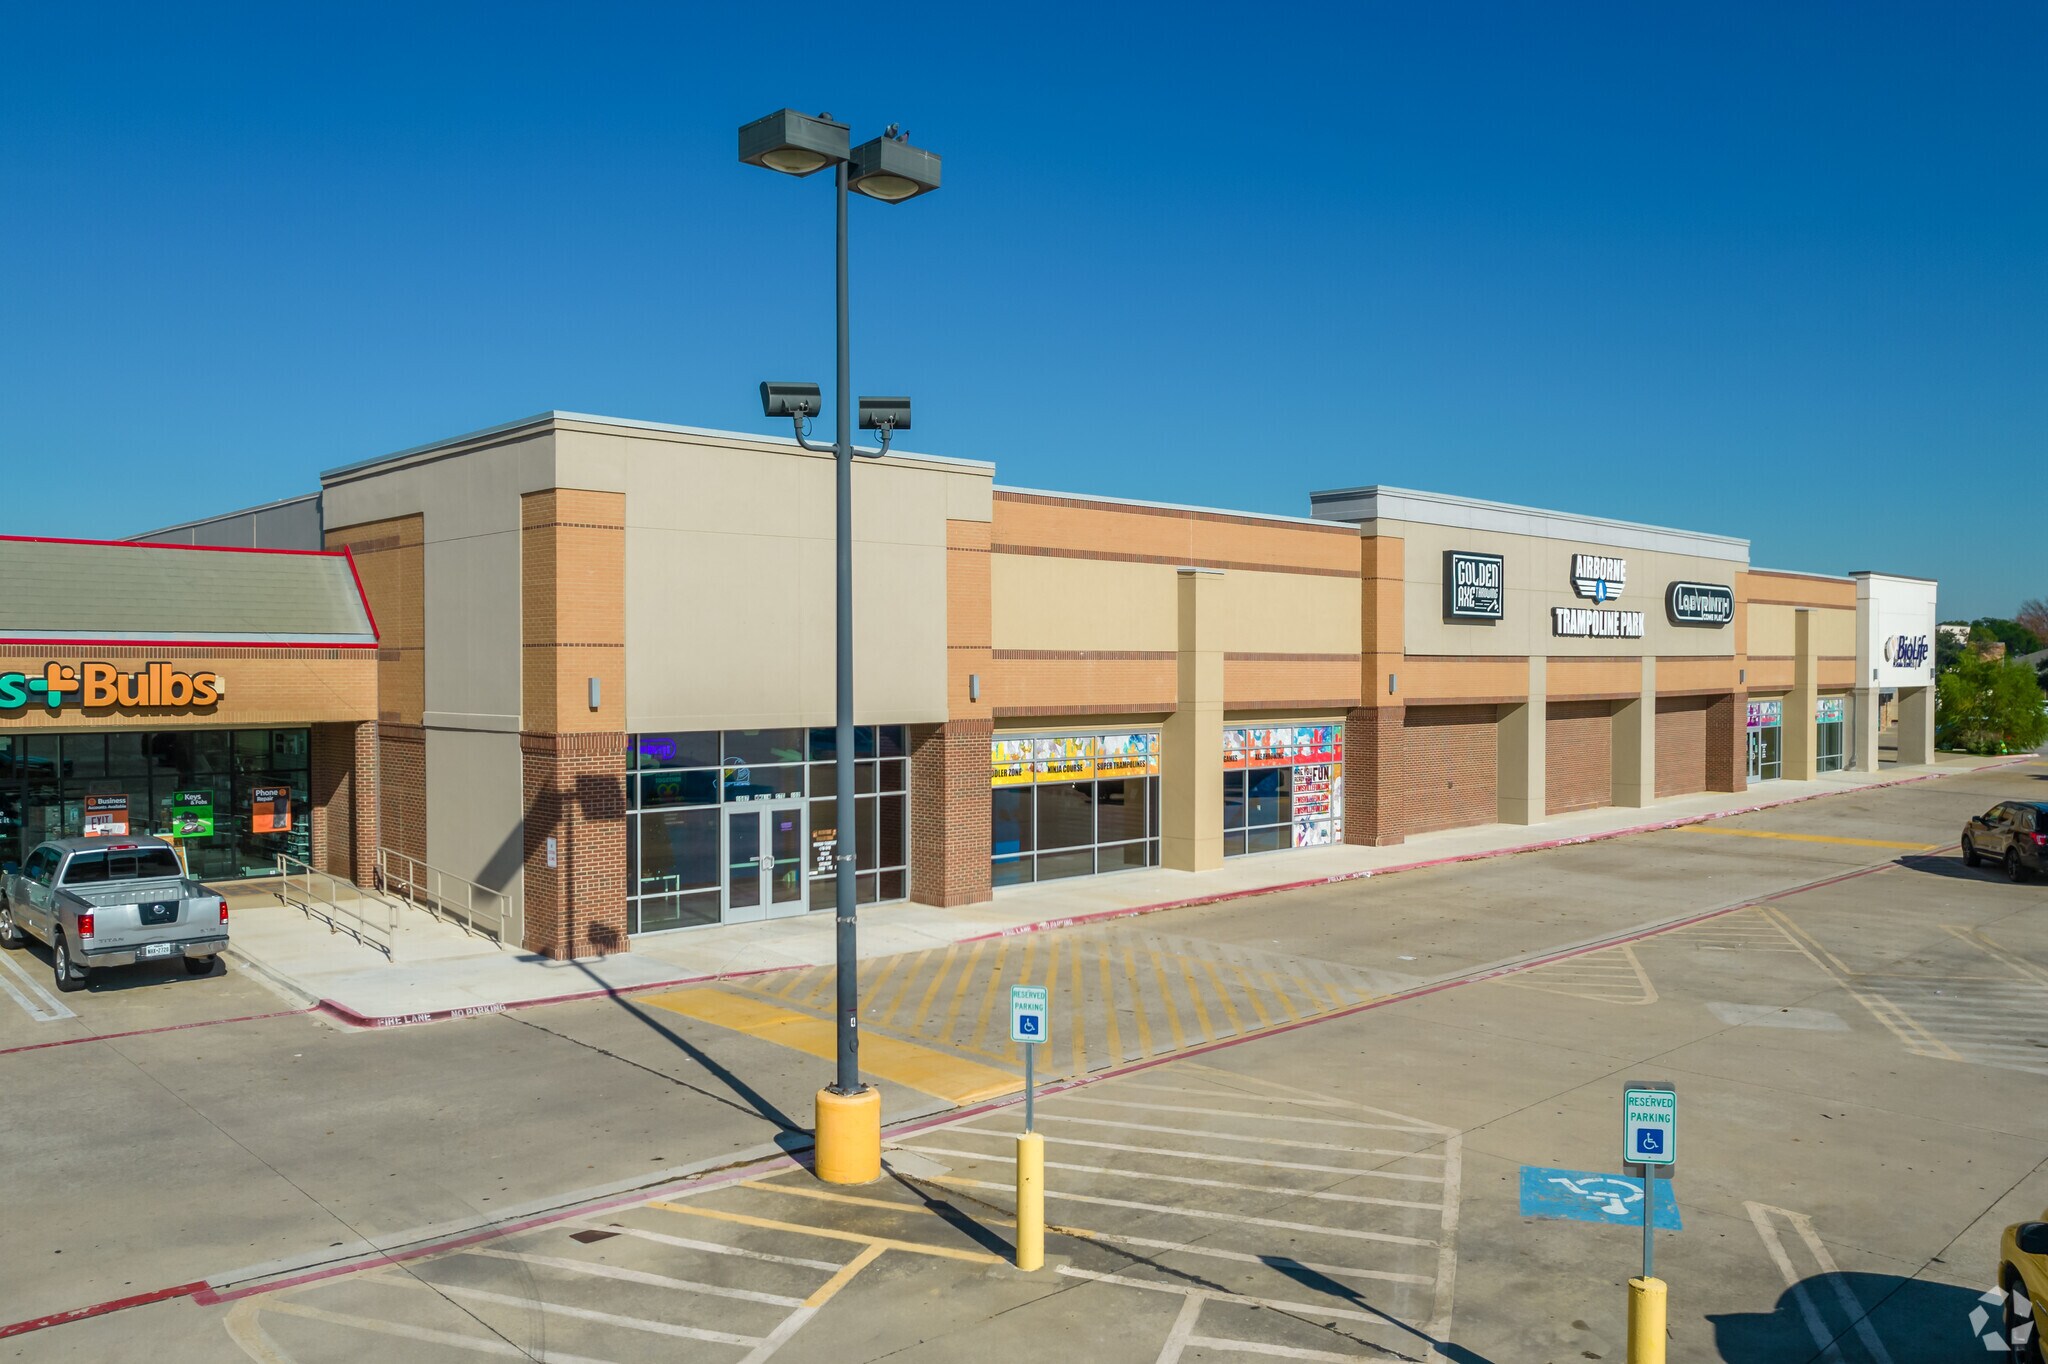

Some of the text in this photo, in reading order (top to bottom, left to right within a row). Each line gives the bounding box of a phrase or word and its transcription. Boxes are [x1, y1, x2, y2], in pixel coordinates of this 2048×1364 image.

[1457, 561, 1498, 587] GOLDEN
[1576, 555, 1626, 581] AIRBORNE
[1458, 586, 1475, 607] AXE
[1556, 608, 1644, 636] TRAMPOLINE PARK
[1897, 635, 1928, 667] BioLife
[83, 663, 218, 707] Bulbs
[1047, 764, 1083, 774] NINJA COURSE
[1097, 760, 1146, 771] SUPER TRAMPOLINES
[1009, 768, 1022, 777] ZONE
[1313, 767, 1329, 780] FUN
[1013, 990, 1045, 999] RESERVED
[1015, 1002, 1043, 1011] PARKING
[378, 1004, 506, 1026] FIRE LANE NO PARKING
[1628, 1096, 1673, 1107] RESERVED
[1630, 1112, 1671, 1123] PARKING
